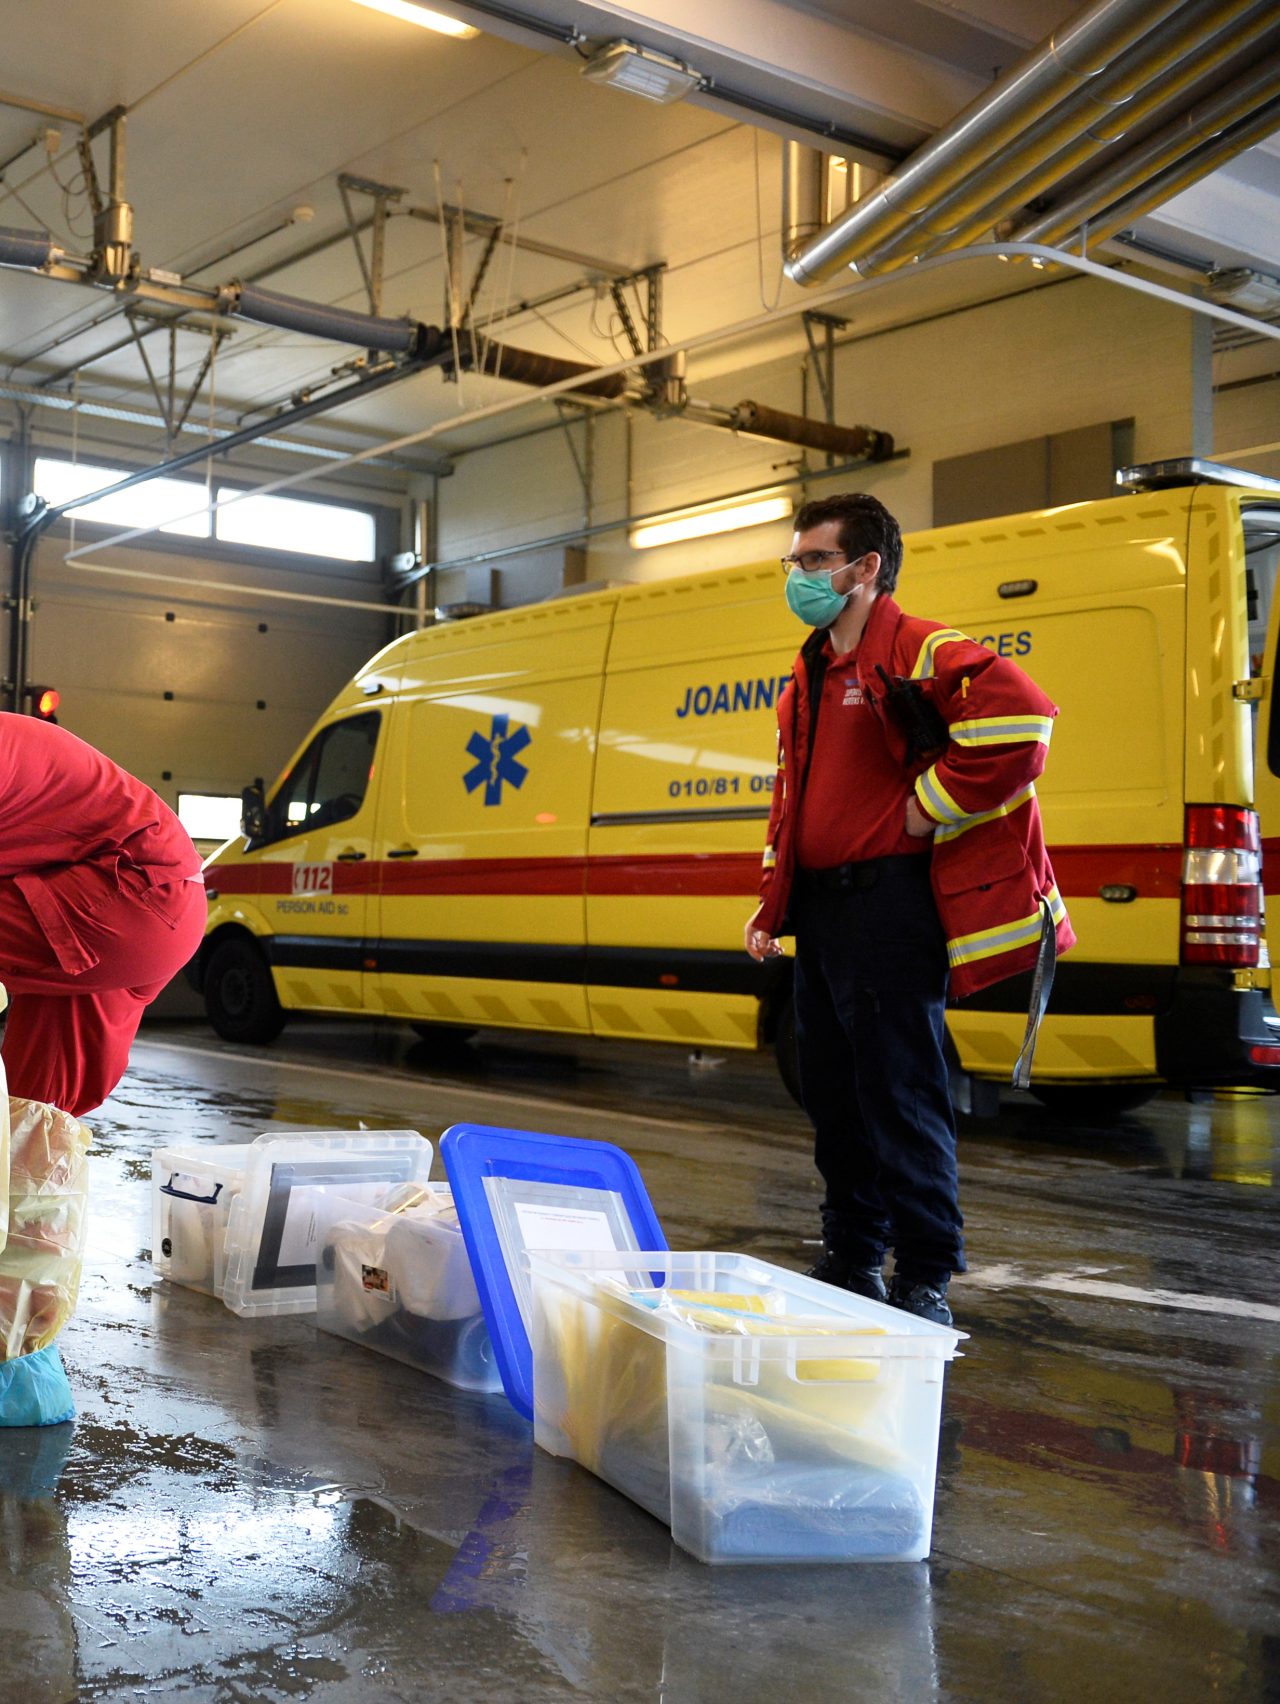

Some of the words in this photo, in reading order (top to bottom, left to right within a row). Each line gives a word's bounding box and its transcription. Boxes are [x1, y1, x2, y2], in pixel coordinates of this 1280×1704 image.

[981, 630, 1032, 657] CES
[669, 777, 739, 797] 010/81
[303, 866, 331, 891] 112
